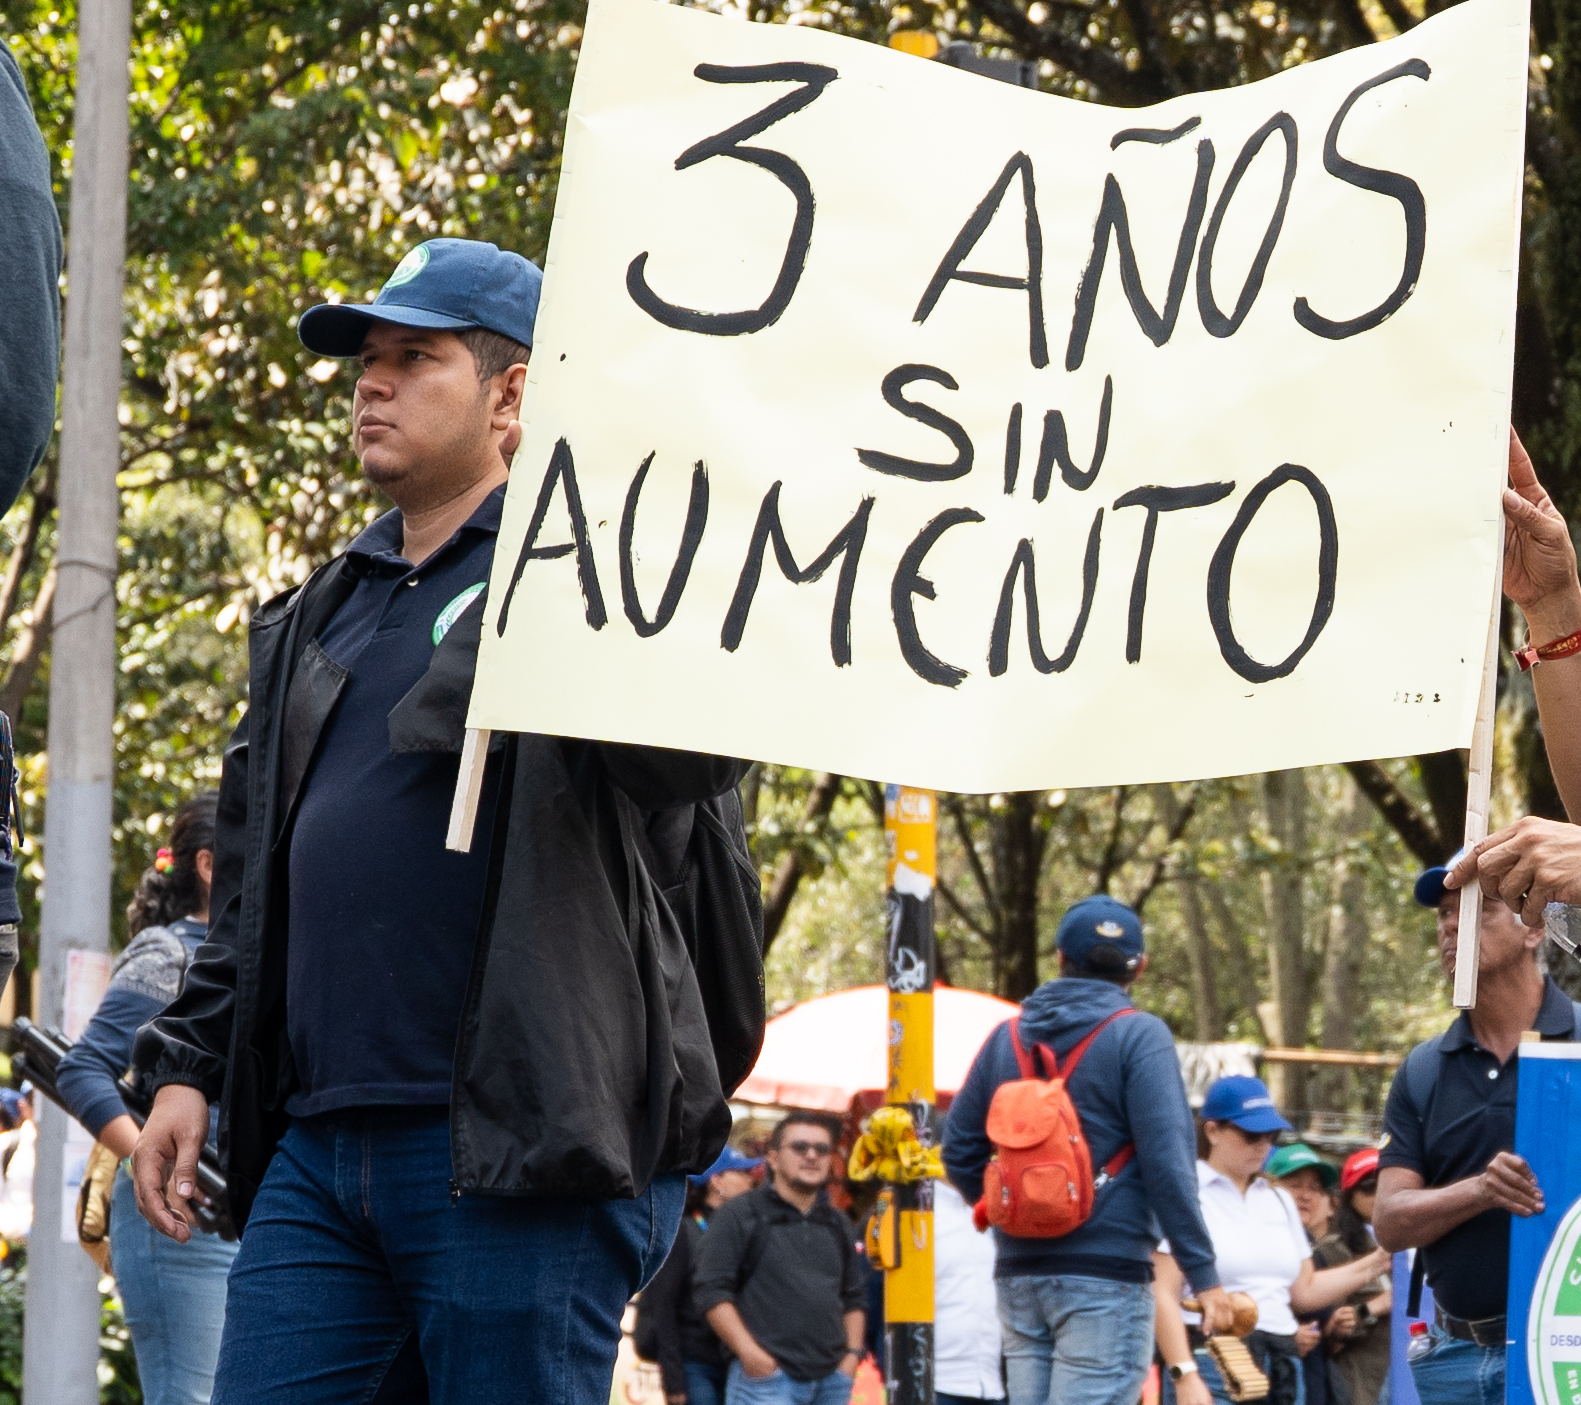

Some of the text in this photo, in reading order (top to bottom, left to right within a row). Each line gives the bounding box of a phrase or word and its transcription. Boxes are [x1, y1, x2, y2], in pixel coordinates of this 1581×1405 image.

[626, 58, 1432, 372] 3 AÑOS
[857, 363, 1113, 504] SIN
[497, 436, 1339, 688] AUMENTO
[1567, 1369, 1579, 1390] EN
